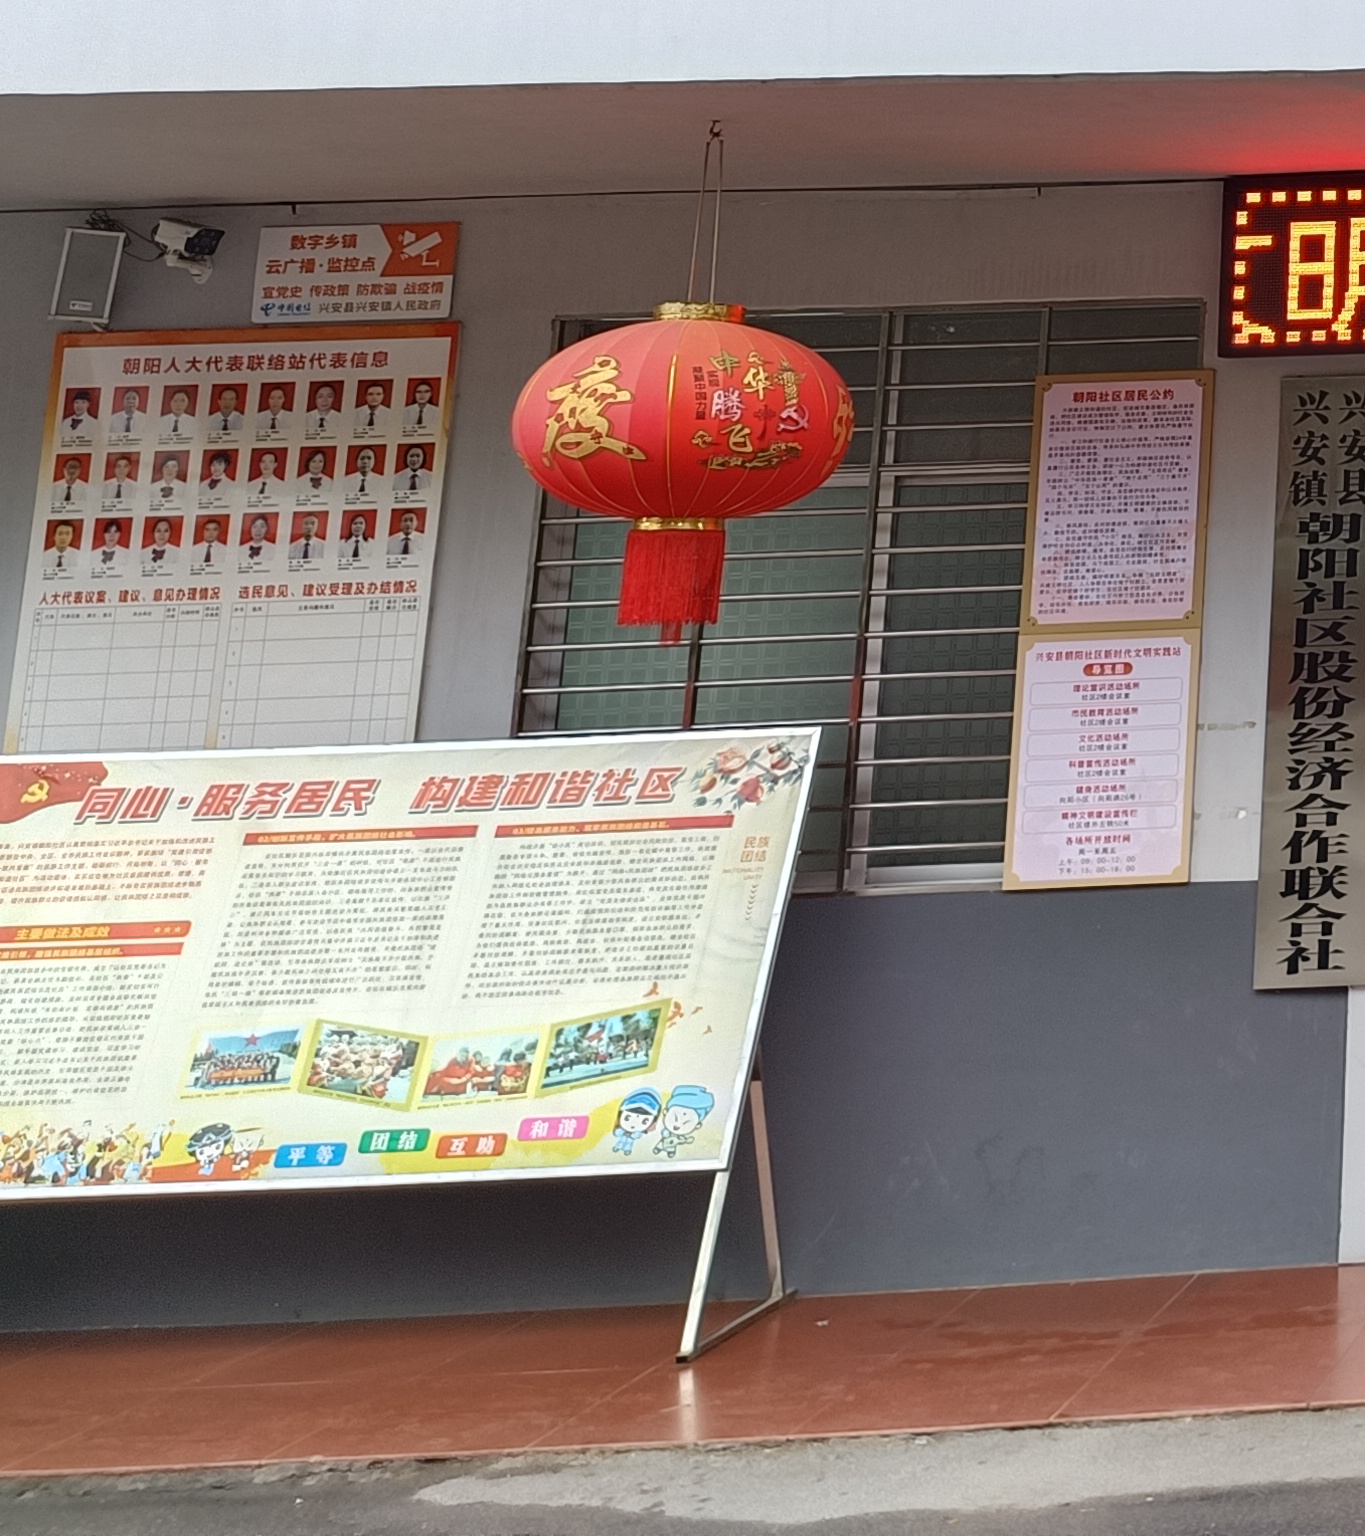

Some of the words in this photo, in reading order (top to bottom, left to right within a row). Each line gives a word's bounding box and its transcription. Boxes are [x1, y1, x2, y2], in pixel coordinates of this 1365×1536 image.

[289, 233, 358, 251] 数字乡镇
[265, 257, 376, 275] 云广播·监控点
[261, 286, 303, 299] 宣党史
[309, 284, 350, 298] 传政策
[356, 283, 397, 296] 防欺骗
[403, 281, 444, 295] 战疫情
[318, 299, 442, 314] 兴安县兴安镇人民政府
[122, 350, 389, 375] 朝阳人大代表联络站代表信息
[1072, 388, 1175, 404] 朝阳社区居民公约
[1289, 390, 1332, 508] 兴安镇
[1276, 512, 1364, 976] 朝阳社区股份经济合作联合社
[73, 779, 382, 825] 同心·服务居民
[408, 766, 687, 814] 构建和谐社区
[740, 850, 767, 863] 团结
[15, 926, 111, 941] 主要做法及成效
[287, 1145, 336, 1166] 平等
[369, 1128, 419, 1152] 团结
[446, 1135, 497, 1157] 互助
[529, 1117, 578, 1138] 和谐
